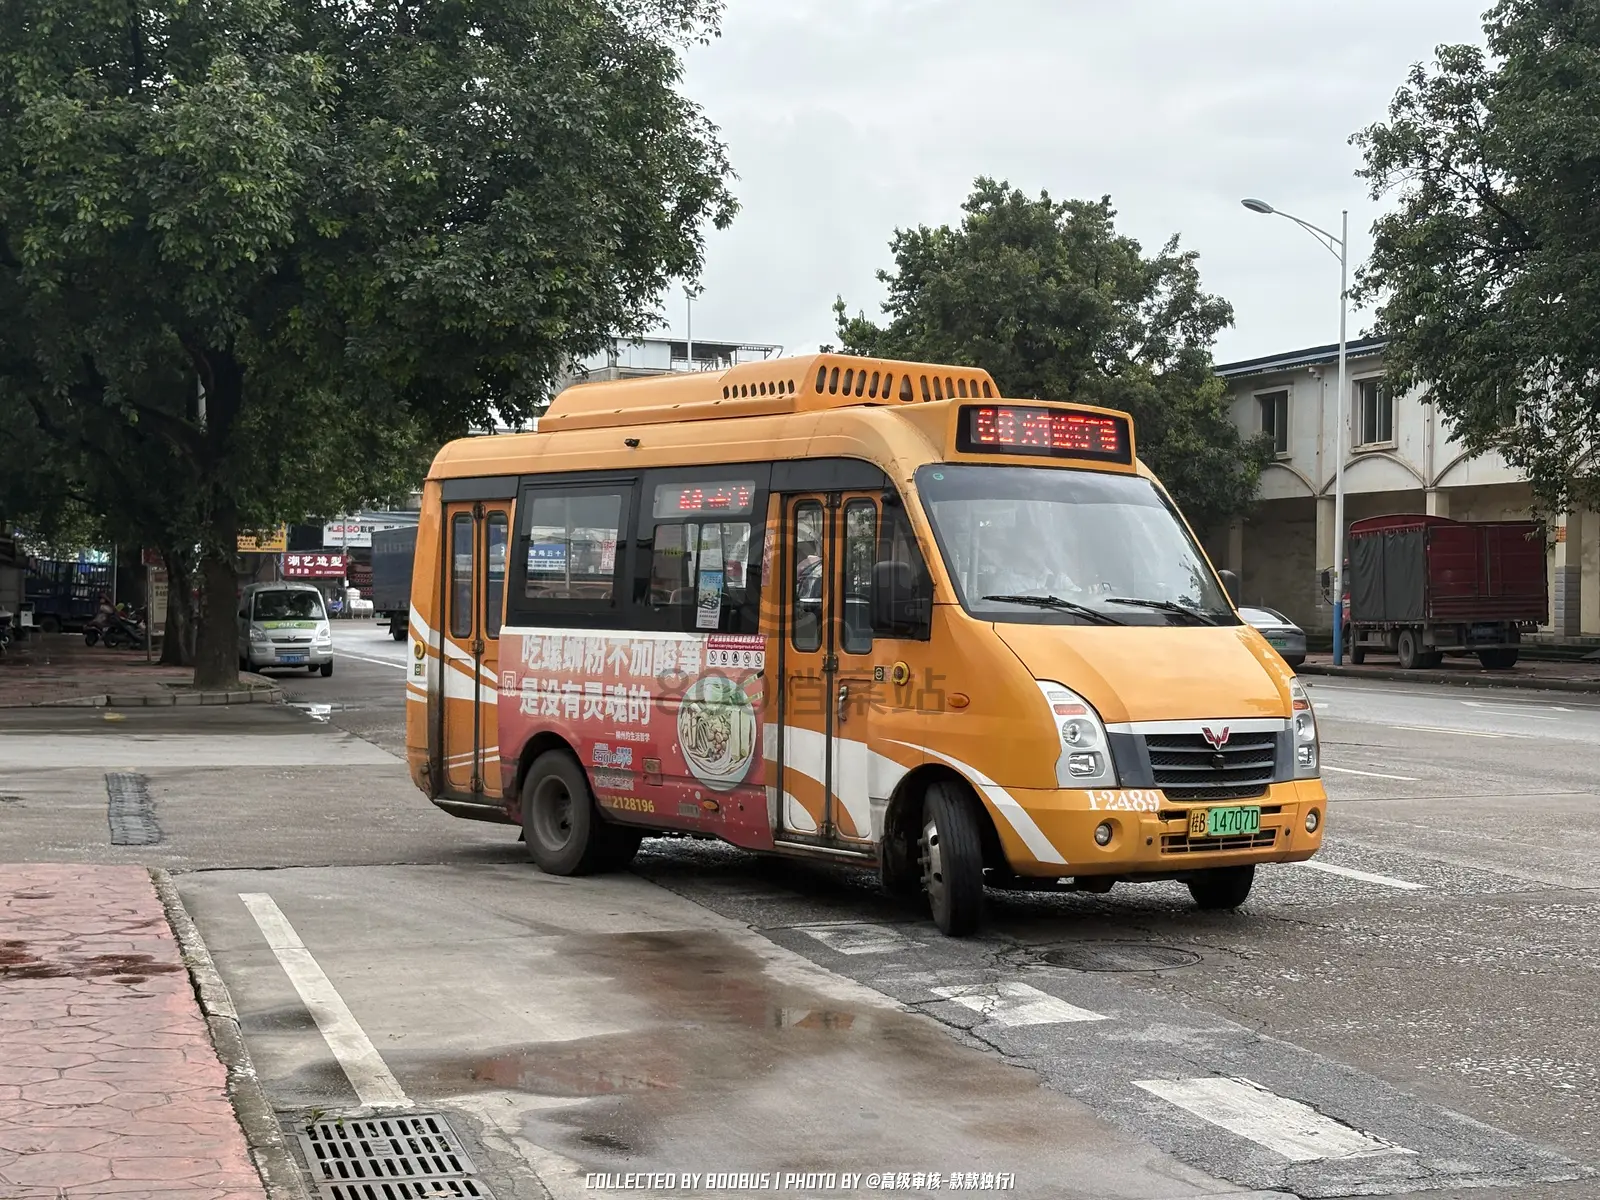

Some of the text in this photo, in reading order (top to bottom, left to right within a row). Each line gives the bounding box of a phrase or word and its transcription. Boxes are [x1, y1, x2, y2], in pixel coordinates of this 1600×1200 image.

[288, 556, 343, 567] 潮艺造型
[521, 635, 702, 679] 吃螺蛳粉不加酸笋
[519, 677, 650, 726] 是没有灵魂的
[612, 795, 655, 813] 2128196
[1085, 790, 1160, 812] 1-2489
